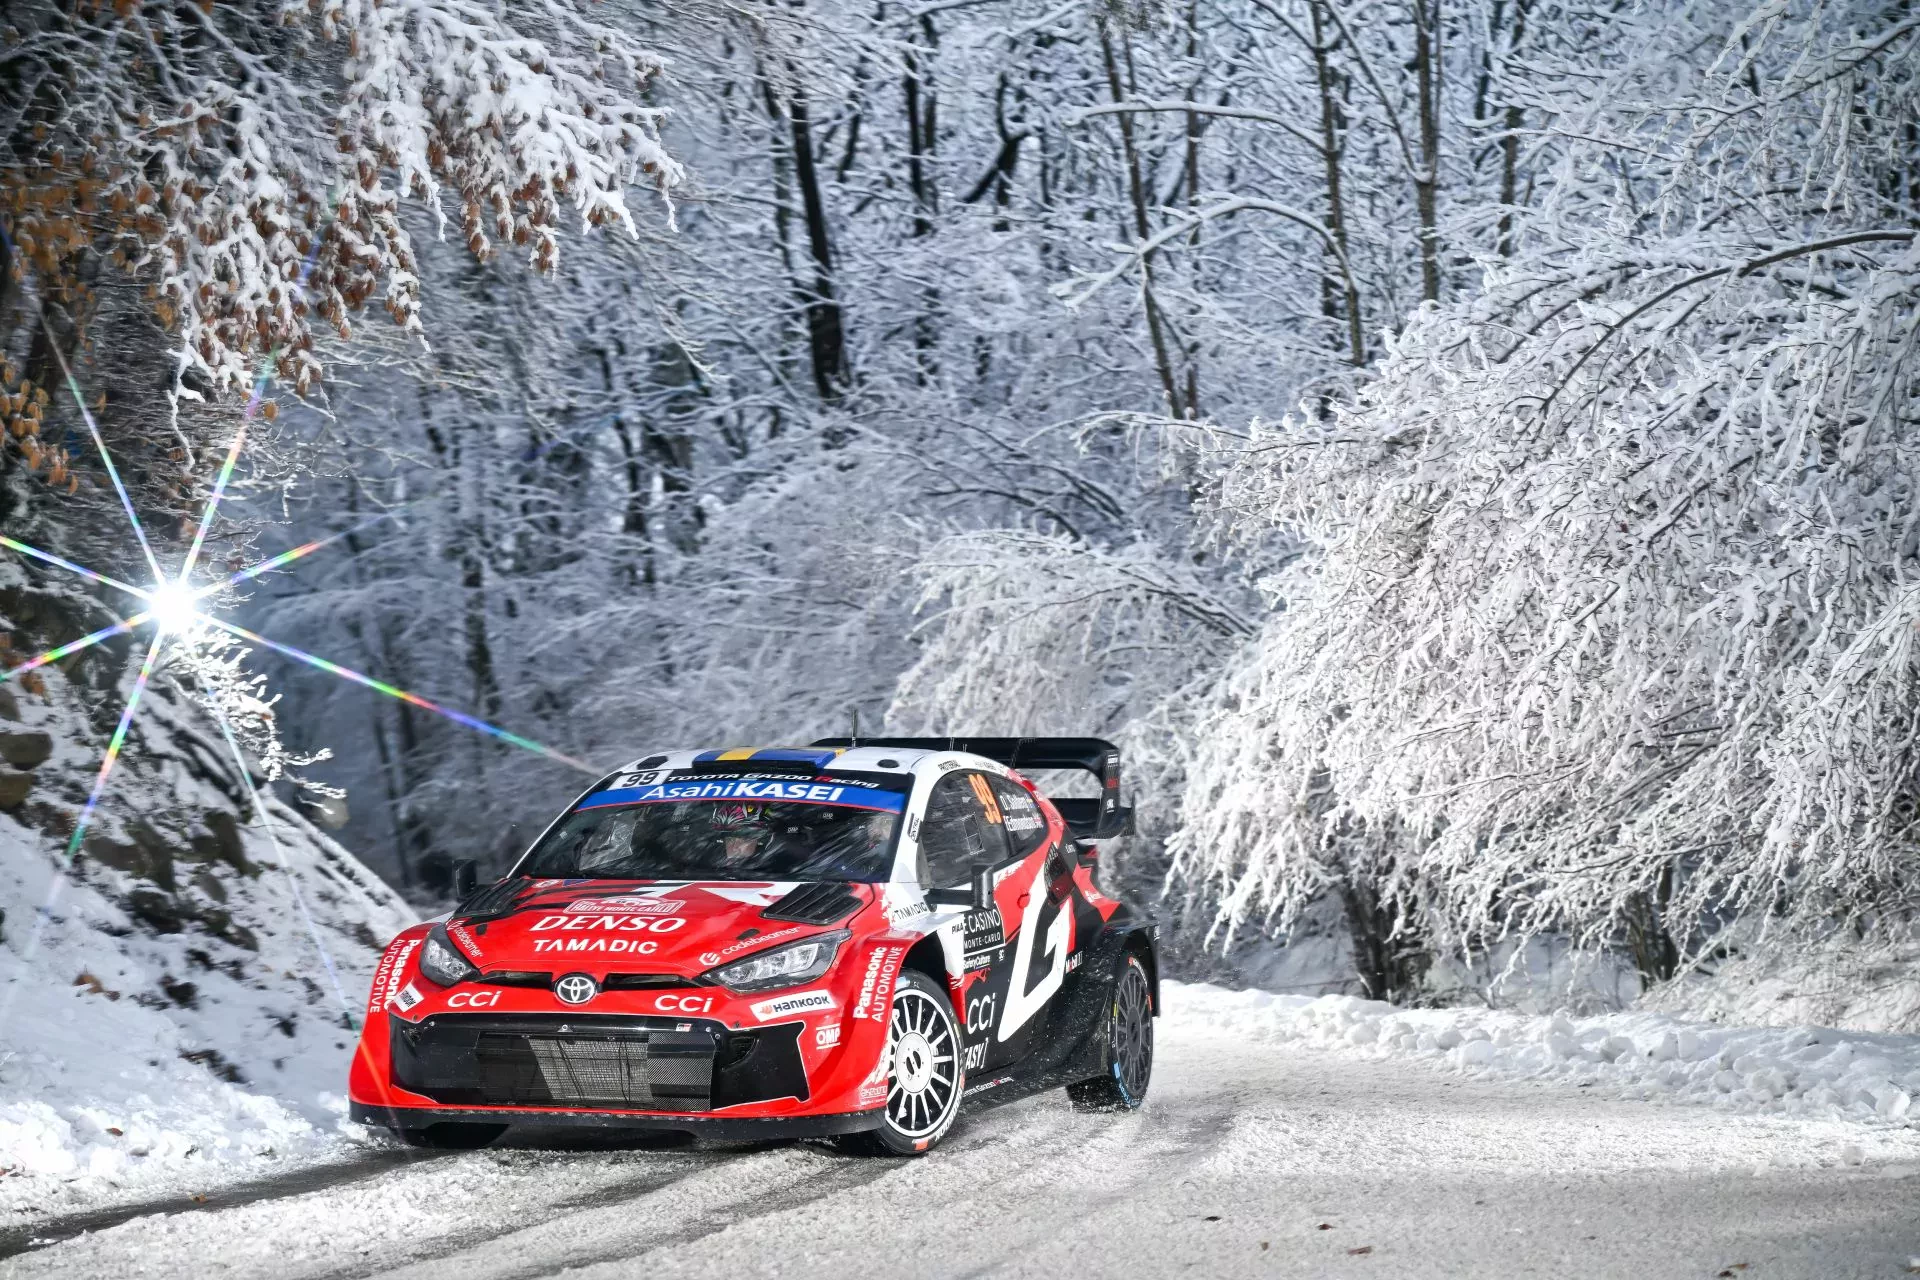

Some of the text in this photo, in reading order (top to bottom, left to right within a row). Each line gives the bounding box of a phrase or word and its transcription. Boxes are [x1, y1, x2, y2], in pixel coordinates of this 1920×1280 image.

[622, 771, 659, 788] 99
[669, 773, 880, 789] TOYOTA GAZOO Racing
[968, 773, 1002, 824] 99
[529, 915, 688, 933] DENSO
[968, 909, 1001, 933] CASINO
[532, 938, 660, 955] TAMADIC
[369, 938, 406, 1014] AUTOMOTIVE
[383, 938, 422, 1011] Panasonic
[852, 946, 888, 1019] Panasonic
[871, 946, 905, 1023] AUTOMOTIVE
[815, 1027, 841, 1046] OMP
